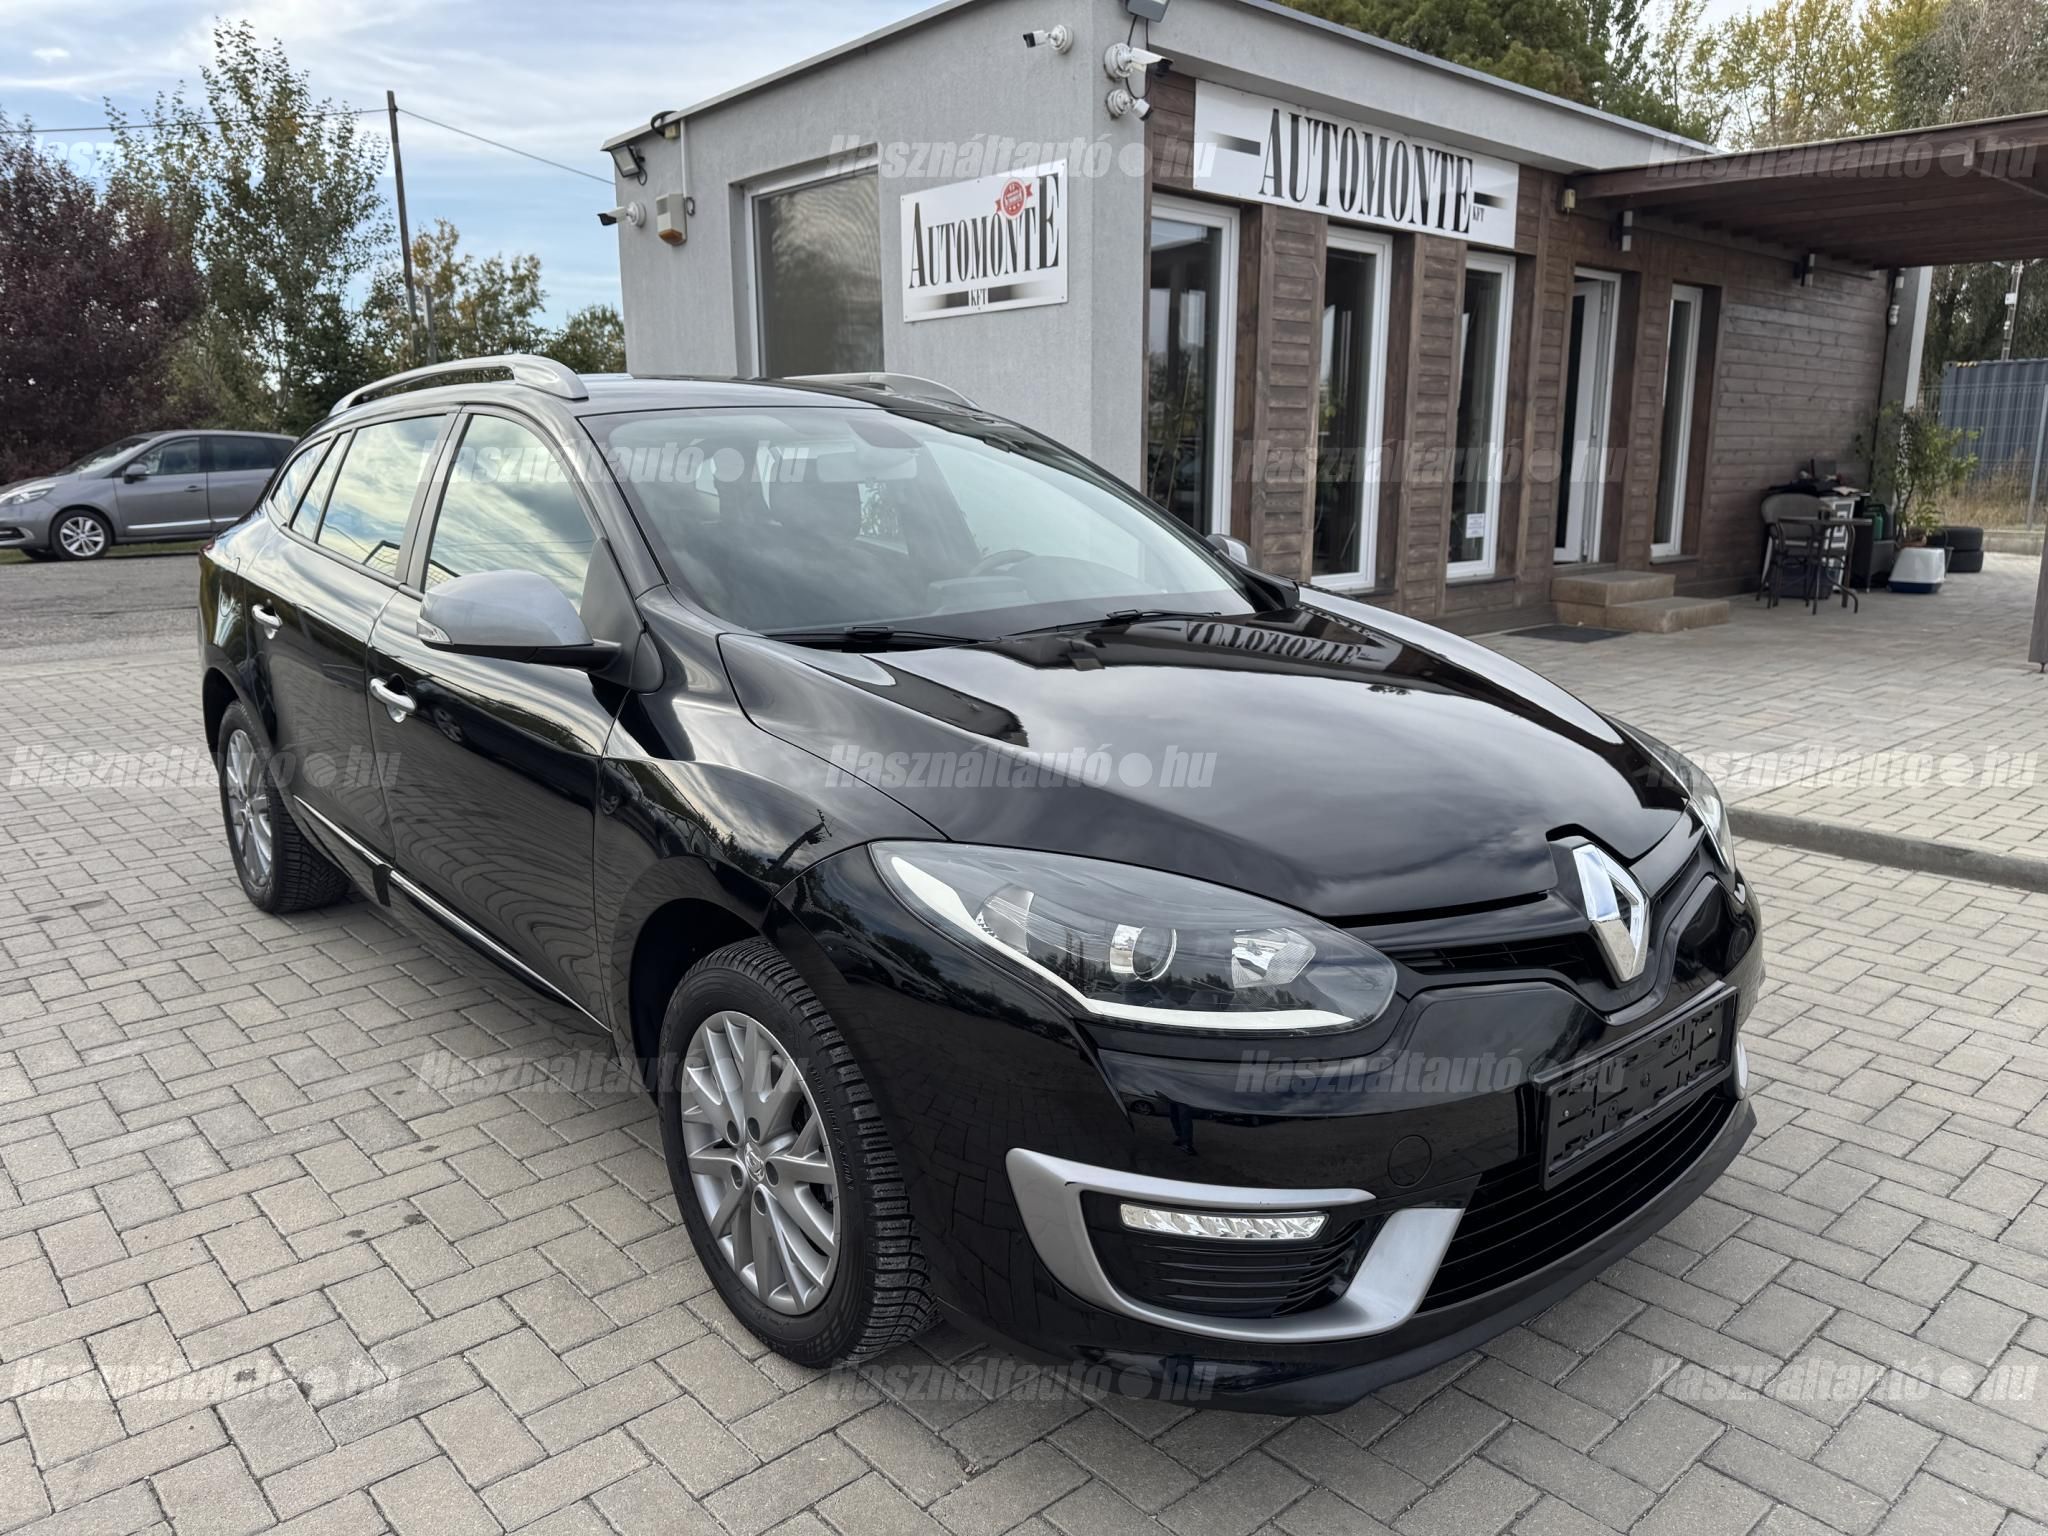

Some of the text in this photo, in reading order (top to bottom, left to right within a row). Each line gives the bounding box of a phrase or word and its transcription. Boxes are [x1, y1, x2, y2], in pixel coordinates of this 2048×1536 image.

[1258, 109, 1474, 234] AUTOMONTE
[909, 173, 1059, 289] AUTOMONTE
[970, 288, 988, 307] KFT
